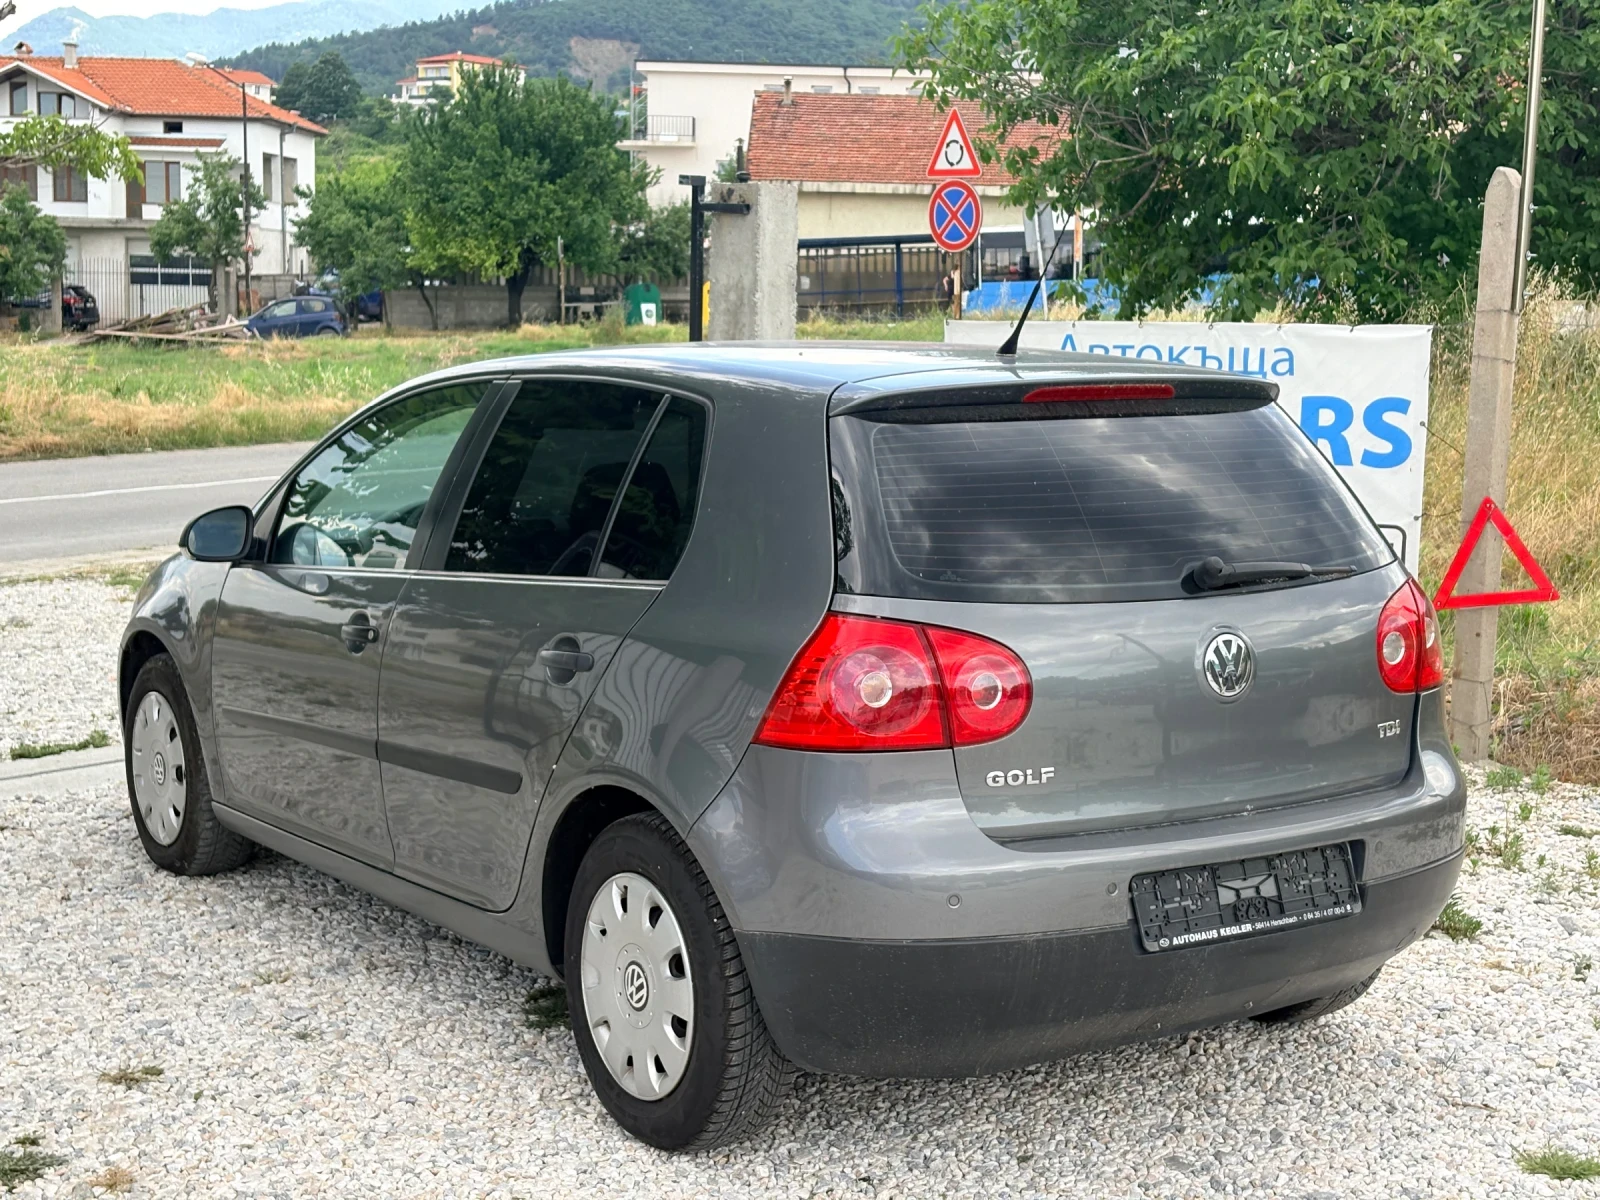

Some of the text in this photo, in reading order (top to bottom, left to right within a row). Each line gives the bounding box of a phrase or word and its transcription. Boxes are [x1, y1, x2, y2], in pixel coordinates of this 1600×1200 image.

[1377, 719, 1400, 738] TDI
[986, 766, 1055, 787] GOLF
[1173, 930, 1218, 945] AUTOHAUS
[1220, 924, 1252, 936] KEGLER
